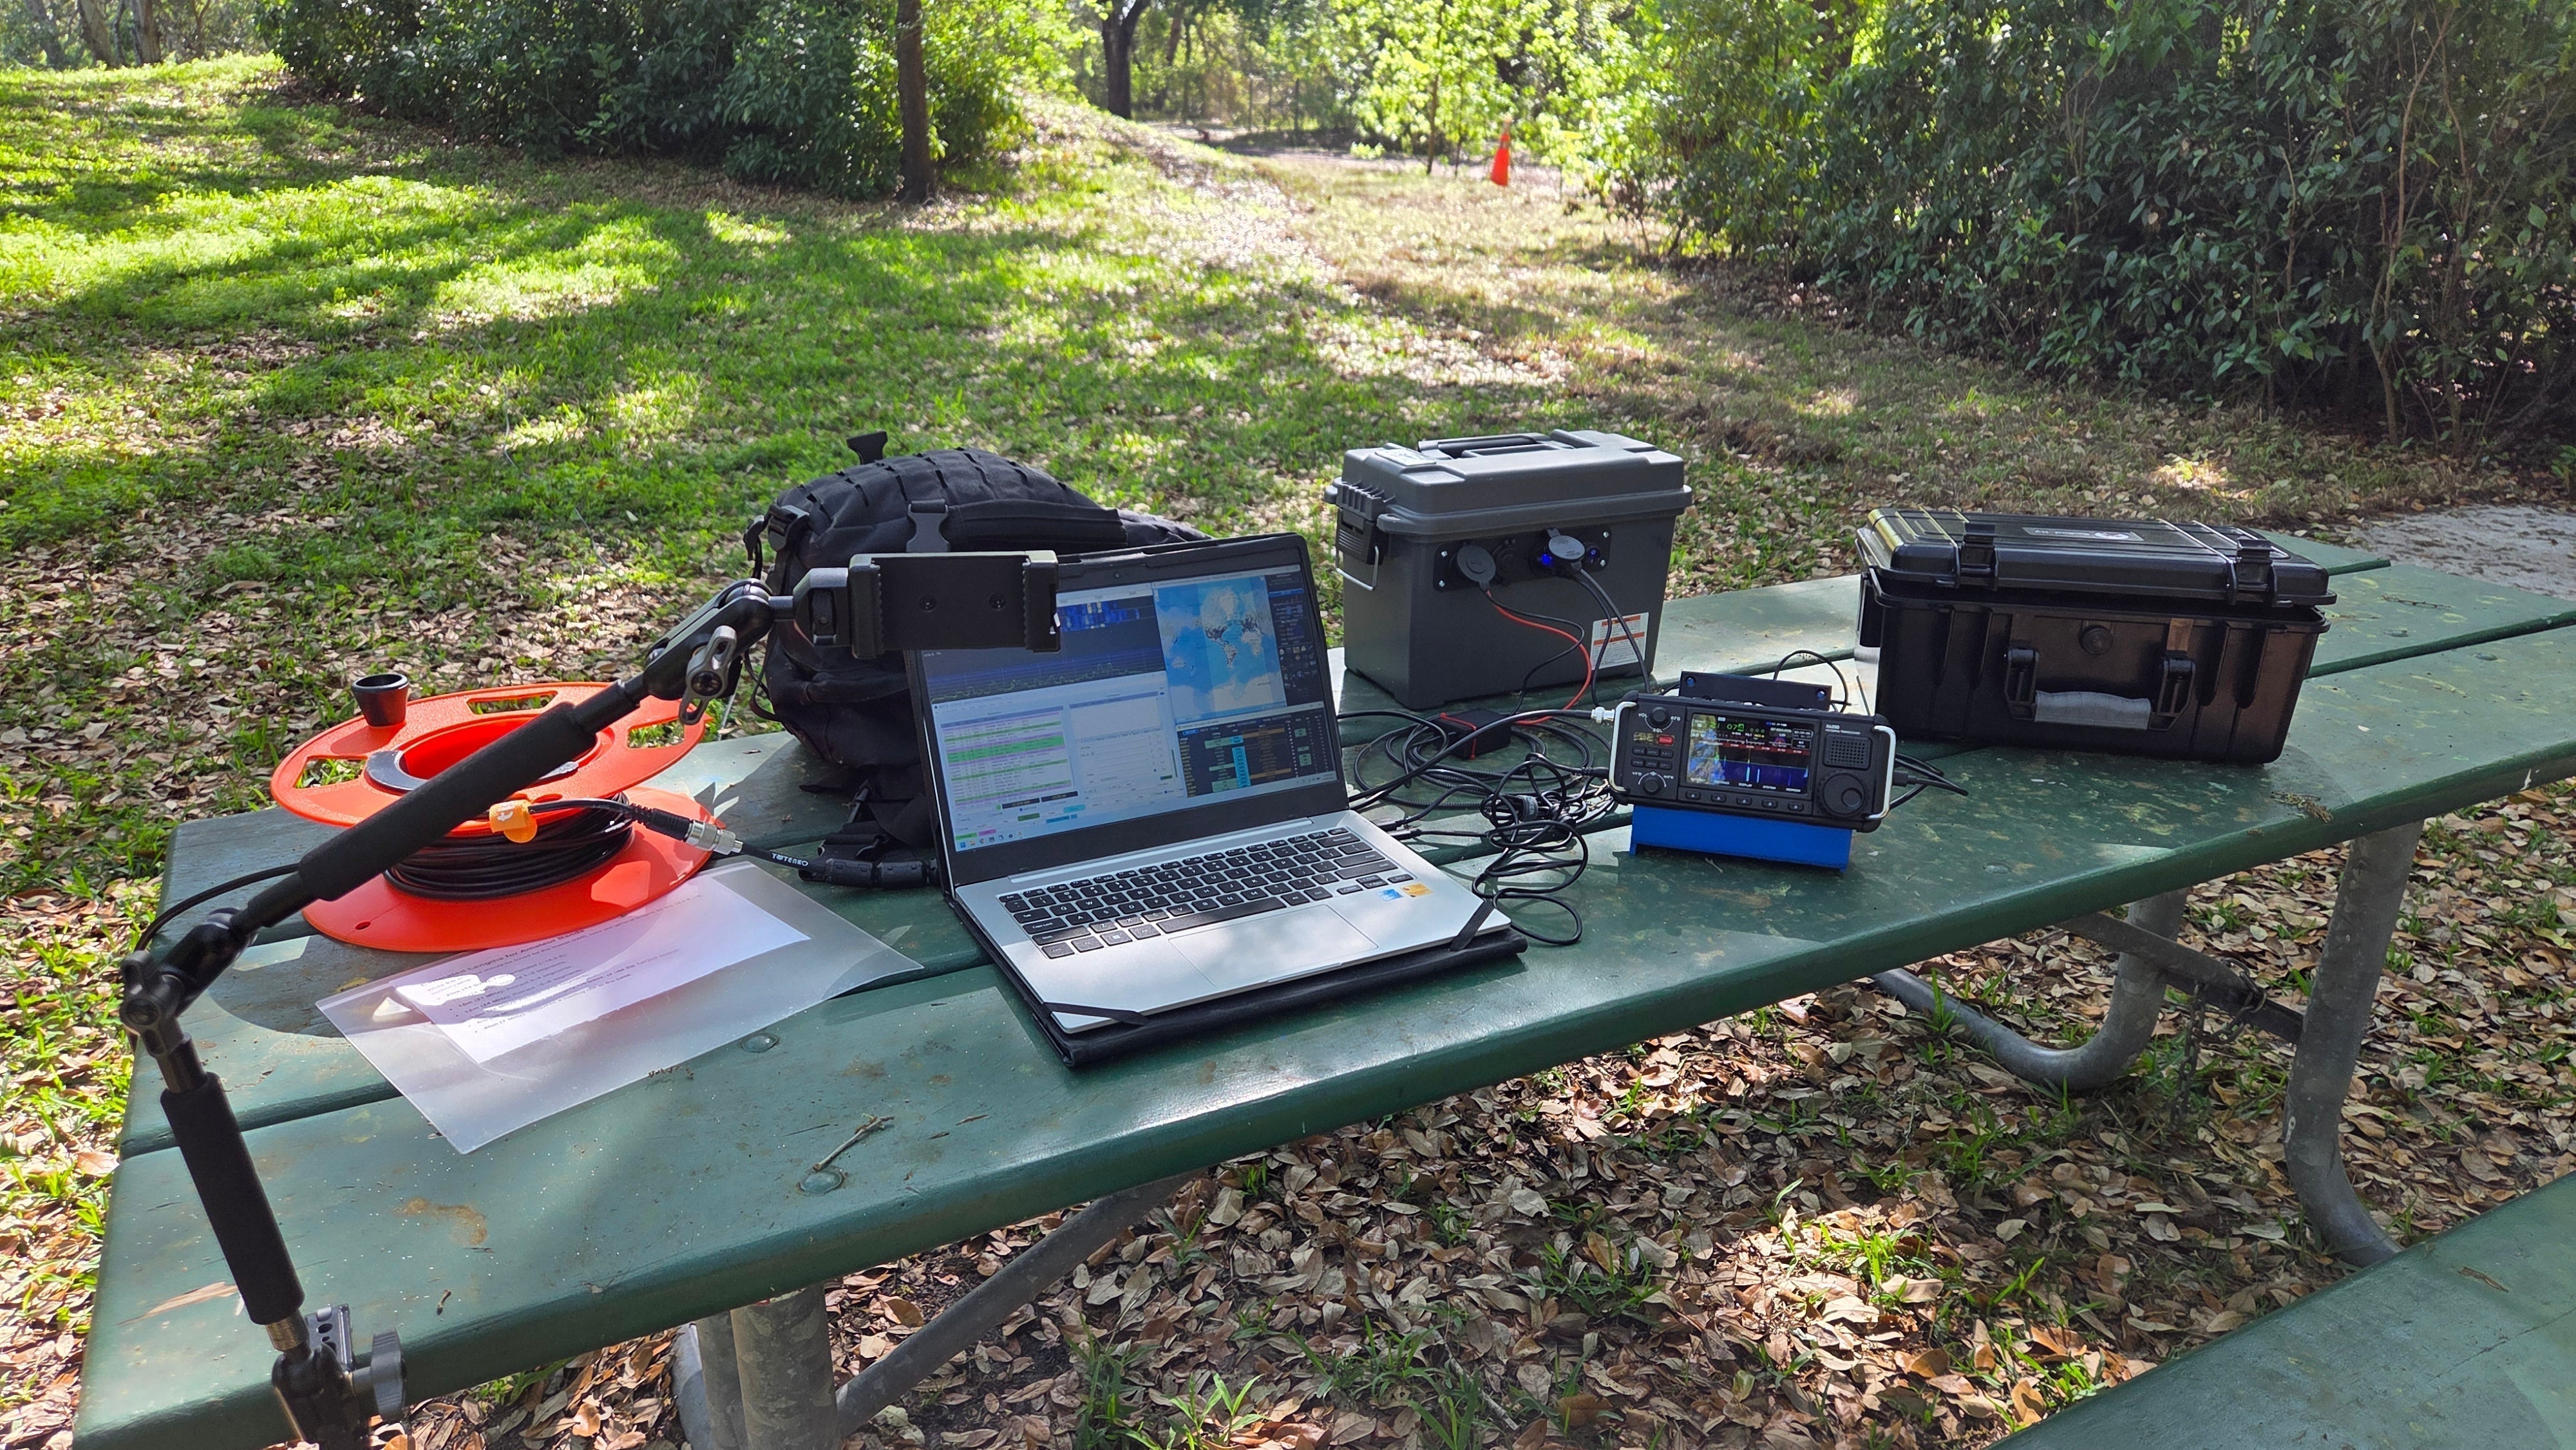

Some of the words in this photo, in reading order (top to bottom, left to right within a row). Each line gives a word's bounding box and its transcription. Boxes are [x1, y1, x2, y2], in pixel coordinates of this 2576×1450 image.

[468, 957, 504, 971] Lengths
[520, 939, 555, 953] Amateur
[558, 929, 585, 941] Bands
